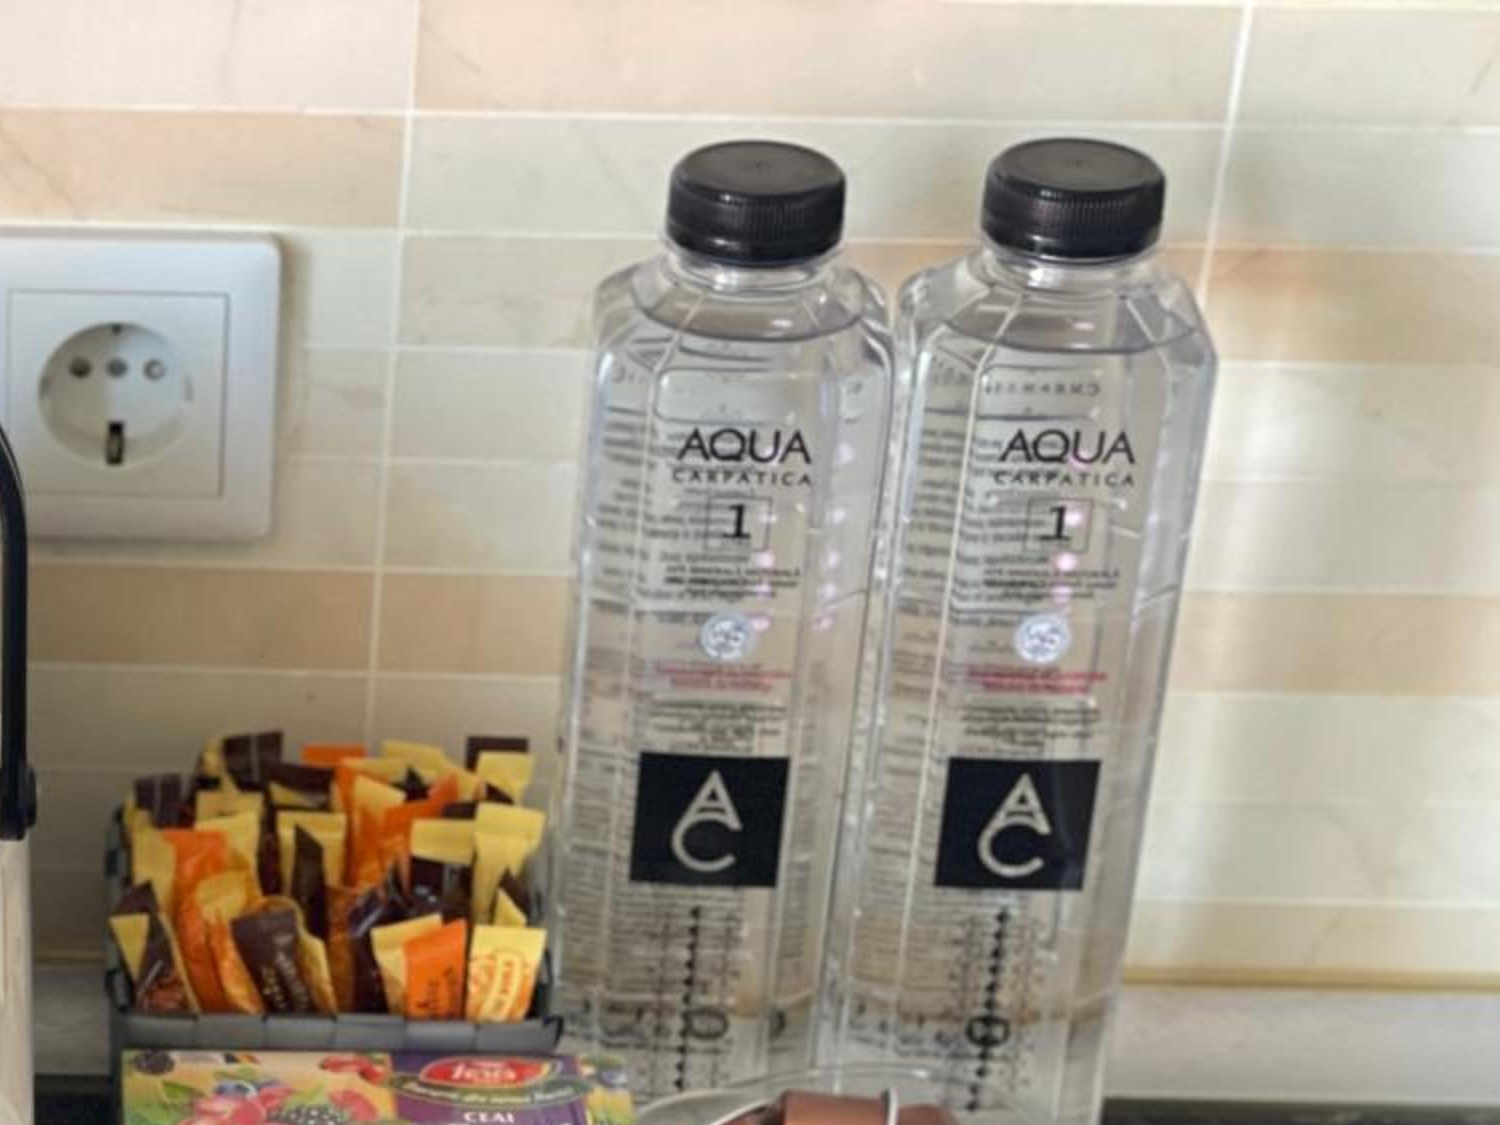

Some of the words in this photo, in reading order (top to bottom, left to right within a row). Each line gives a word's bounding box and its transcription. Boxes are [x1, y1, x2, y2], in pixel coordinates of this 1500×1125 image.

[676, 427, 812, 464] AQUA
[1000, 428, 1135, 465] AQUA
[672, 468, 813, 487] CARPATICA
[993, 471, 1135, 488] CARPATICA
[722, 503, 752, 539] 1
[1039, 505, 1071, 541] 1
[463, 1111, 515, 1124] CEAI
